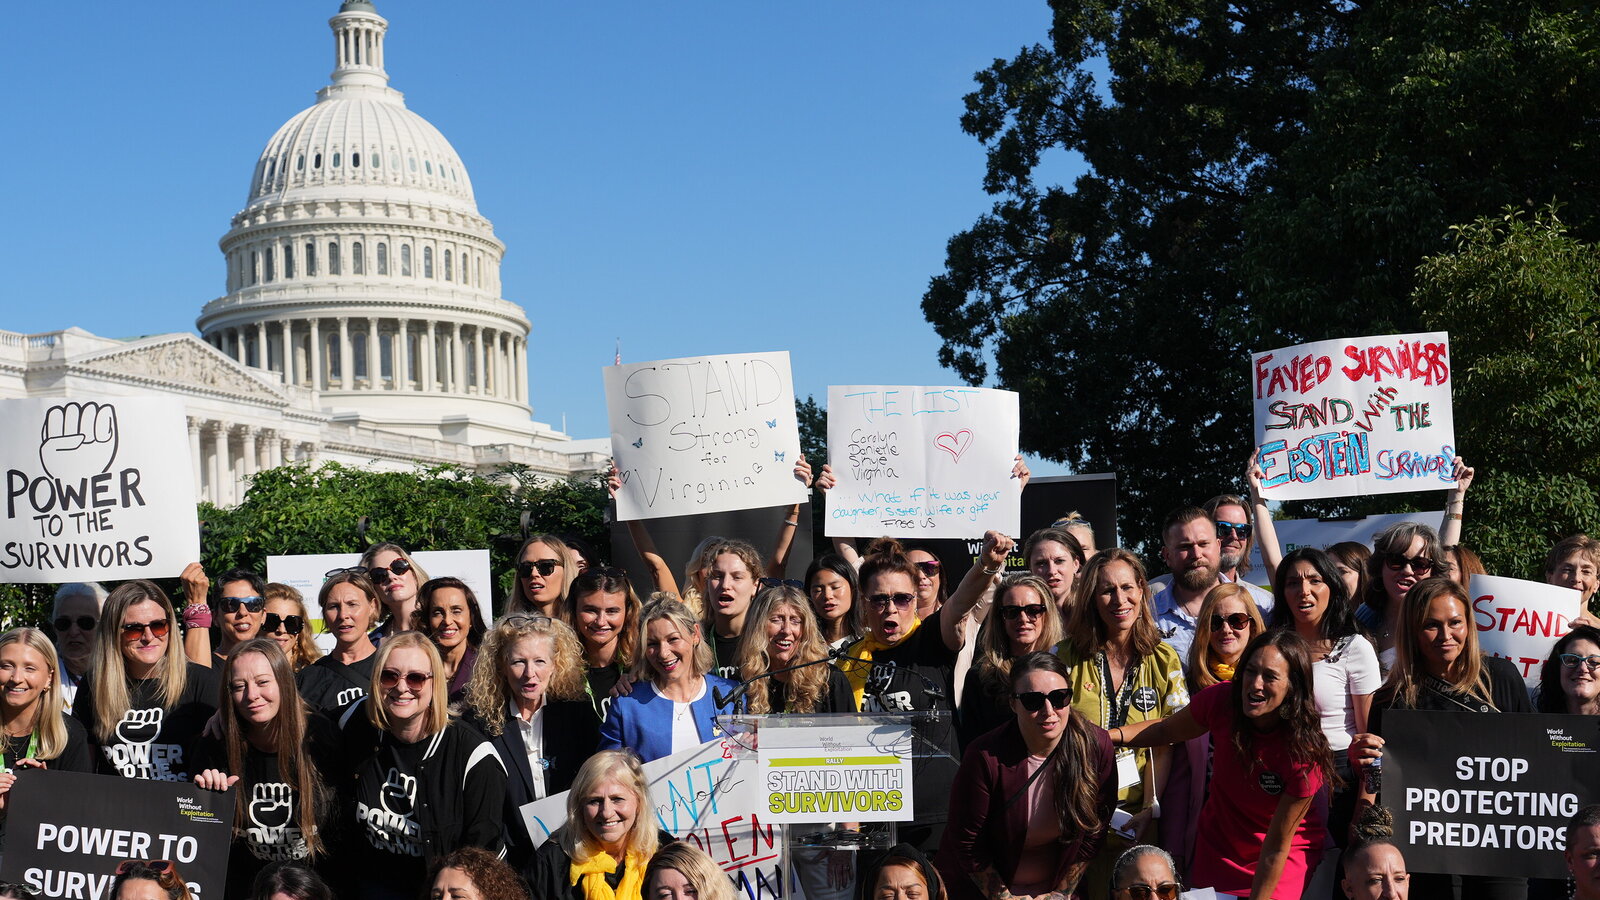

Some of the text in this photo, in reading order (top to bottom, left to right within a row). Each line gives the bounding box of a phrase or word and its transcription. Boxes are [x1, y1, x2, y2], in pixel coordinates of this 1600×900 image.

[1256, 353, 1332, 399] FAYED
[625, 359, 782, 426] STAND
[845, 389, 980, 423] THE LIST
[1265, 397, 1354, 431] STAND
[1390, 402, 1432, 431] THE
[668, 421, 760, 451] Strong
[701, 452, 727, 465] for
[7, 468, 146, 518] POWER
[635, 467, 755, 507] Virginia
[944, 490, 970, 501] was
[33, 508, 114, 538] TO THE
[0, 535, 153, 570] SURVIVORS
[1472, 594, 1571, 638] STAND
[101, 743, 183, 767] POWER
[1456, 756, 1529, 782] STOP
[767, 768, 903, 791] STAND WITH
[180, 809, 214, 817] Exploitation
[768, 790, 903, 814] SURVIVORS
[1406, 787, 1579, 818] PROTECTING
[37, 823, 198, 863] POWER TO
